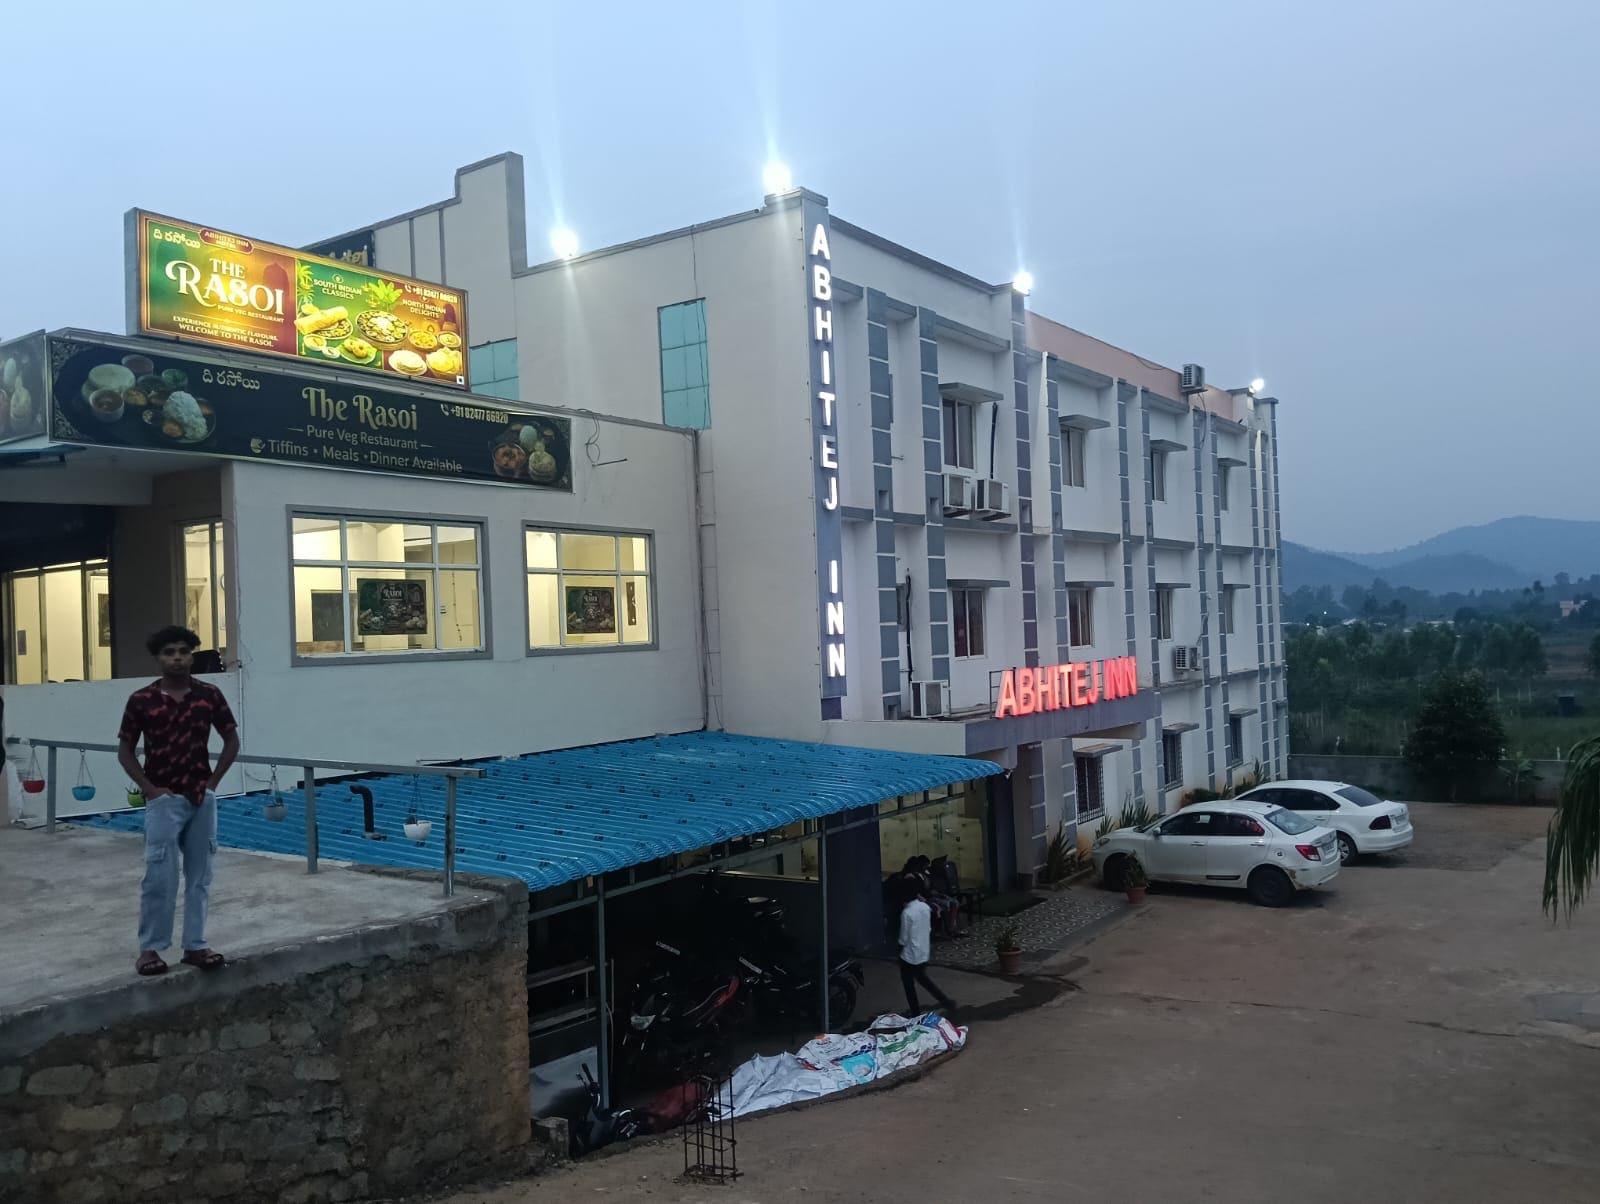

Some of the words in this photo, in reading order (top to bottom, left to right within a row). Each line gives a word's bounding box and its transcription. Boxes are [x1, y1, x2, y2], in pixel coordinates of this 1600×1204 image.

[153, 228, 163, 240] ది
[209, 258, 245, 279] THE
[165, 260, 284, 315] RASOI
[313, 278, 337, 291] SOUTH
[338, 282, 362, 295] INDIAN
[321, 287, 355, 300] CLASSICS
[402, 298, 425, 310] NORTH
[425, 302, 447, 314] INDIAN
[410, 306, 441, 319] DELIGHTS
[173, 315, 211, 329] EXPERIENCE
[235, 308, 247, 316] VEG
[248, 311, 285, 323] RESTAURANT
[179, 323, 219, 337] WELCOME
[220, 331, 231, 339] TO
[233, 333, 248, 342] THE
[202, 368, 214, 384] ది
[302, 386, 348, 422] The
[352, 394, 418, 431] Rasoi
[450, 405, 464, 418] +91
[306, 424, 335, 440] Pure
[335, 429, 358, 446] Veg
[360, 431, 419, 450] Restaurant
[268, 438, 309, 457] Tiffins
[322, 445, 360, 462] Meals
[370, 451, 410, 467] Dinner
[412, 455, 463, 473] Available
[810, 223, 839, 511] ABHITEJ
[826, 559, 846, 678] INN
[994, 661, 1101, 720] ABHITEJ
[1103, 655, 1138, 702] INN
